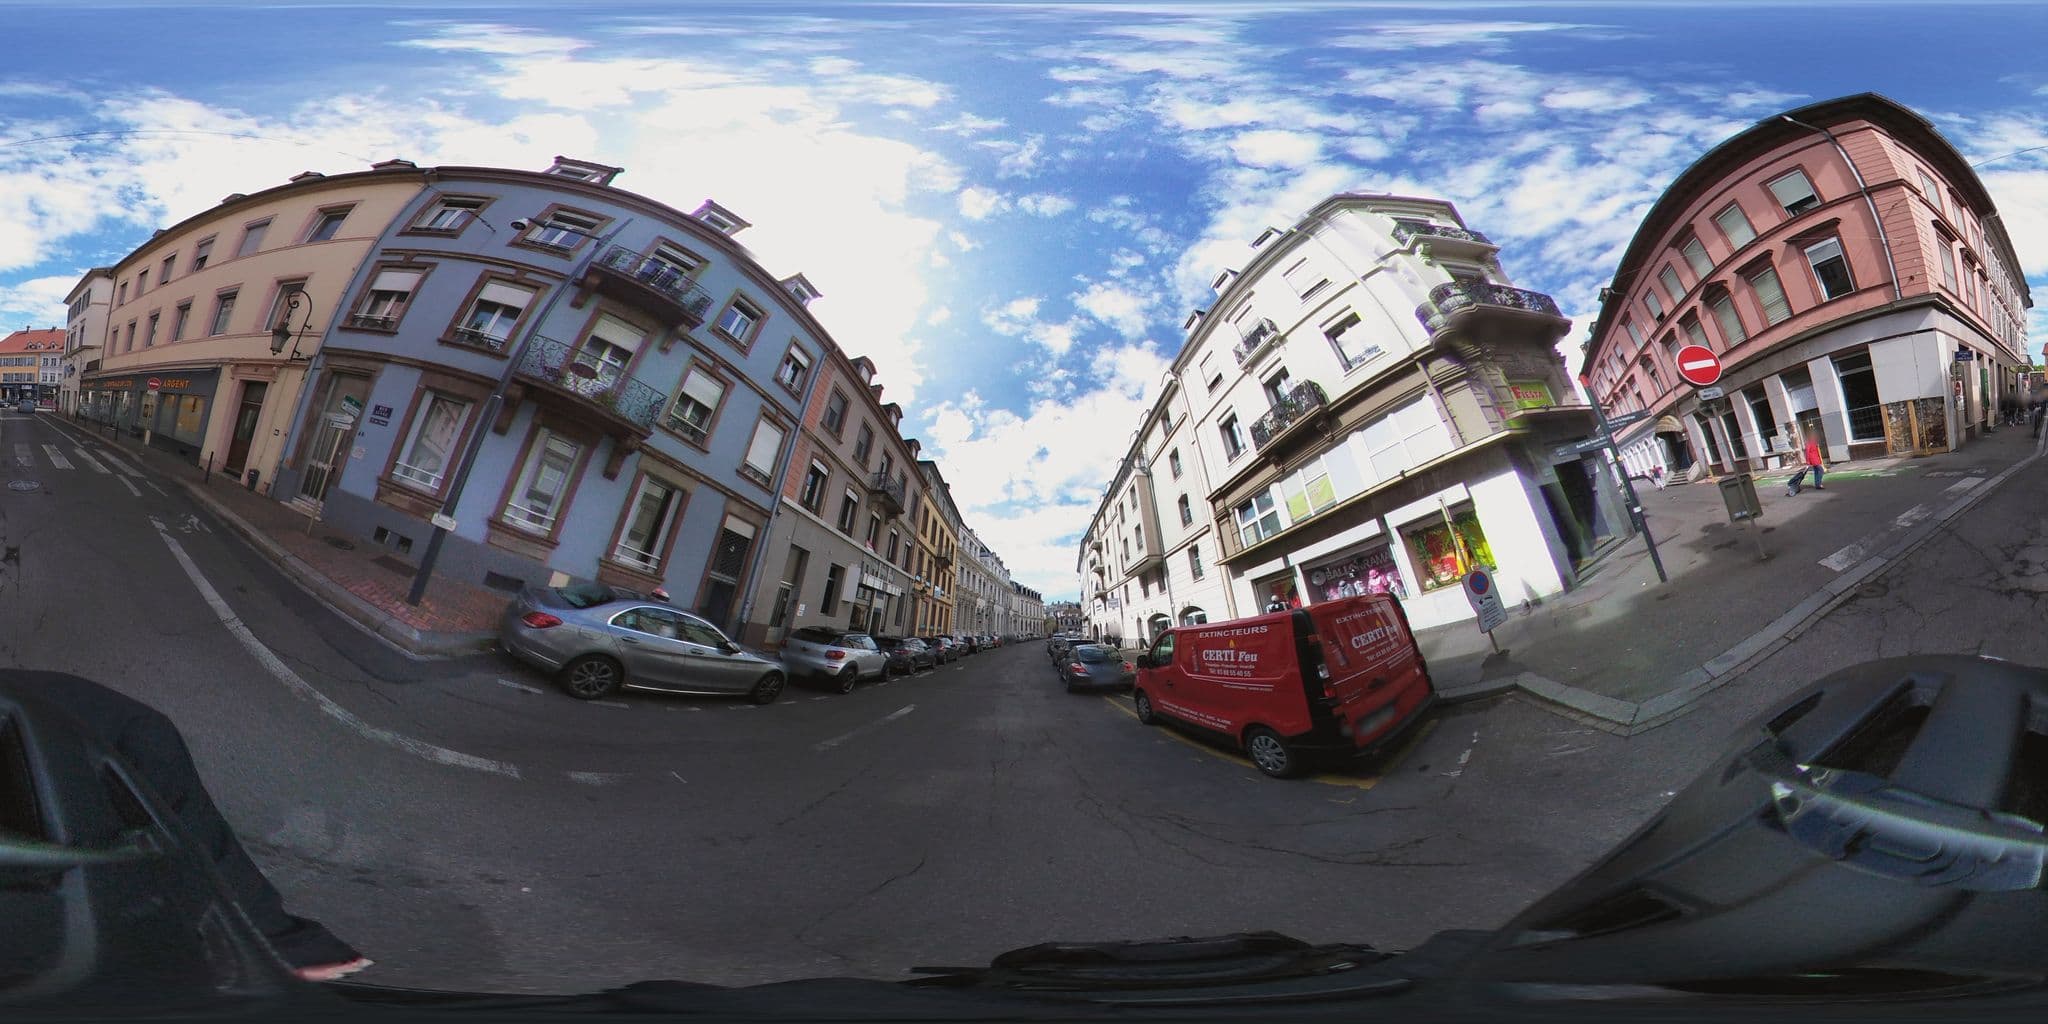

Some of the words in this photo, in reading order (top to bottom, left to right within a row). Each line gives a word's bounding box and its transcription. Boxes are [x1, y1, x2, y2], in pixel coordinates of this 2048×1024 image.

[162, 380, 190, 389] ARGENT
[1510, 386, 1544, 400] FIESTA
[1336, 604, 1385, 624] EXTINCTEU
[1199, 626, 1268, 638] EXTINCTEURS
[1352, 627, 1386, 648] CERTI
[1203, 649, 1235, 661] CERTI
[1238, 651, 1258, 662] Feu
